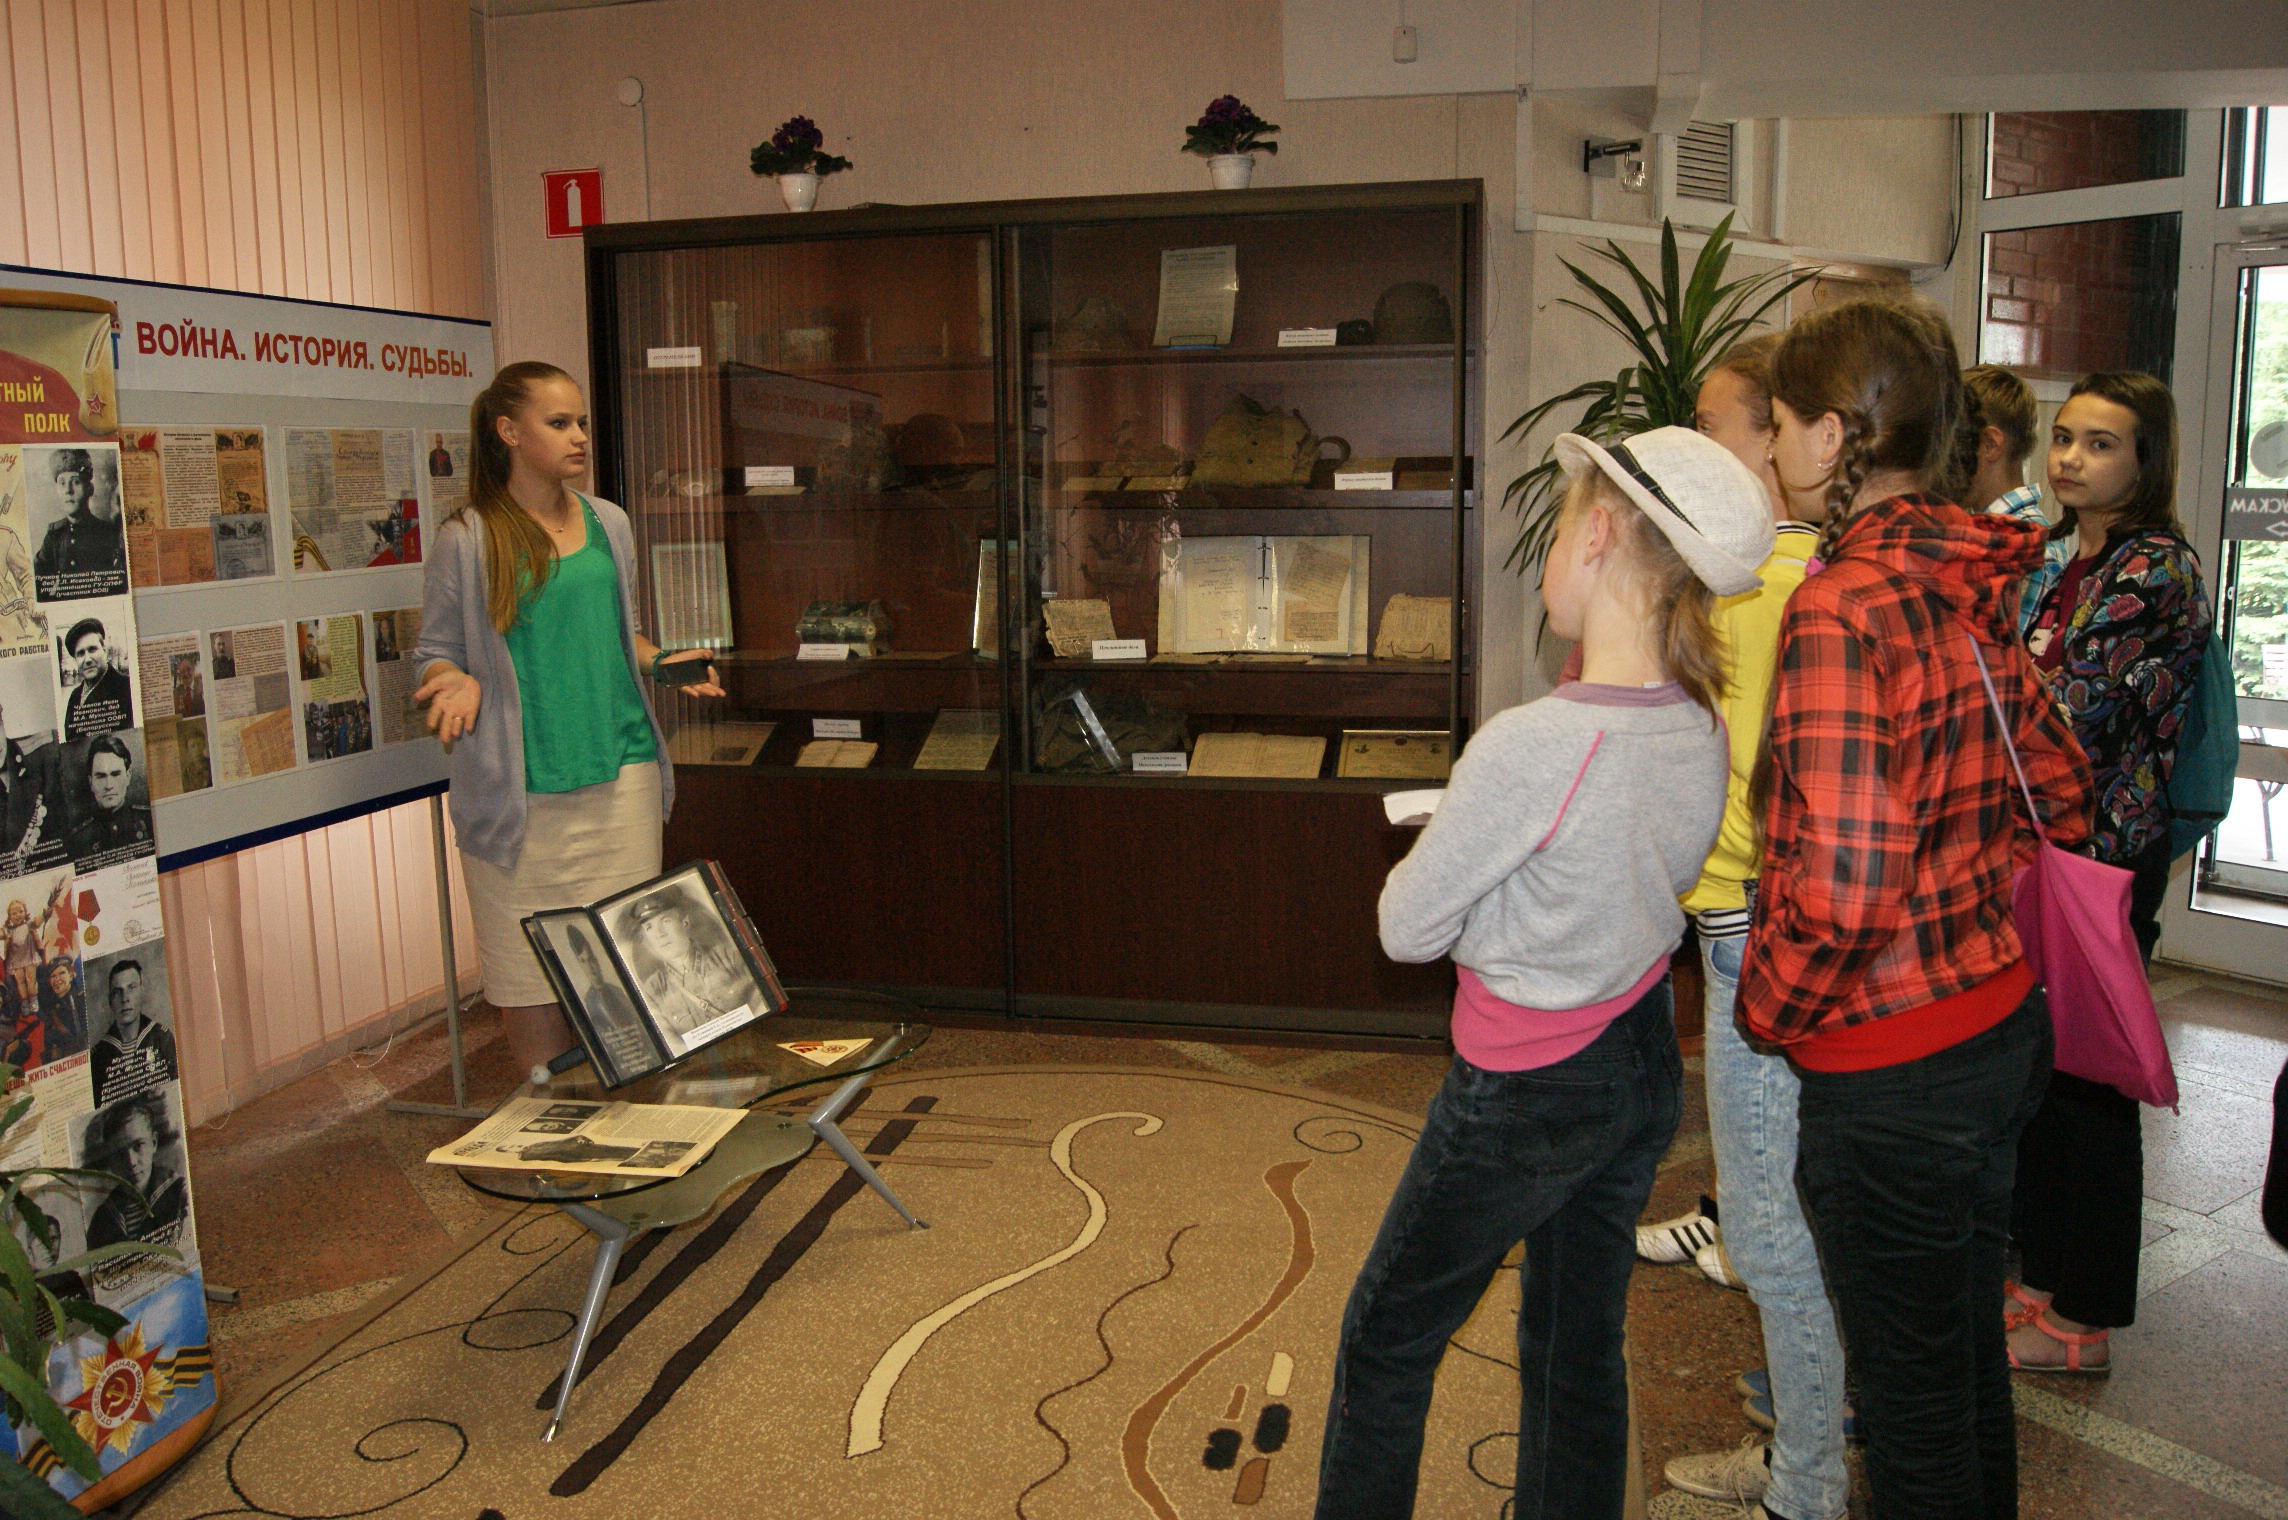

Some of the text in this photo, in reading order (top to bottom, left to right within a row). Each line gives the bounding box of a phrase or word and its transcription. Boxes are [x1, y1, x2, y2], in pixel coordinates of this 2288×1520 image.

[136, 317, 247, 361] ВОЙНА.
[254, 331, 375, 370] ИСТОРИЯ.
[381, 343, 474, 379] СУДЬБЫ.
[24, 413, 71, 433] ПОЛК
[61, 571, 90, 579] Николай
[90, 569, 126, 577] Петрович,
[56, 589, 91, 597] (участник
[20, 644, 50, 656] РАБСТВА
[73, 703, 120, 716] Иванович, дед
[89, 710, 117, 720] Мухиной
[68, 718, 106, 729] начальника
[28, 1068, 48, 1084] ЖИТЬ
[49, 1051, 89, 1076] СЧАСТЛИВО!
[105, 1056, 145, 1074] Петрович,
[102, 1068, 144, 1088] начальника
[101, 1080, 146, 1102] Балтийский
[94, 1360, 143, 1426] ОТЕЧЕСТВЕННАЯ ВОЙНА
